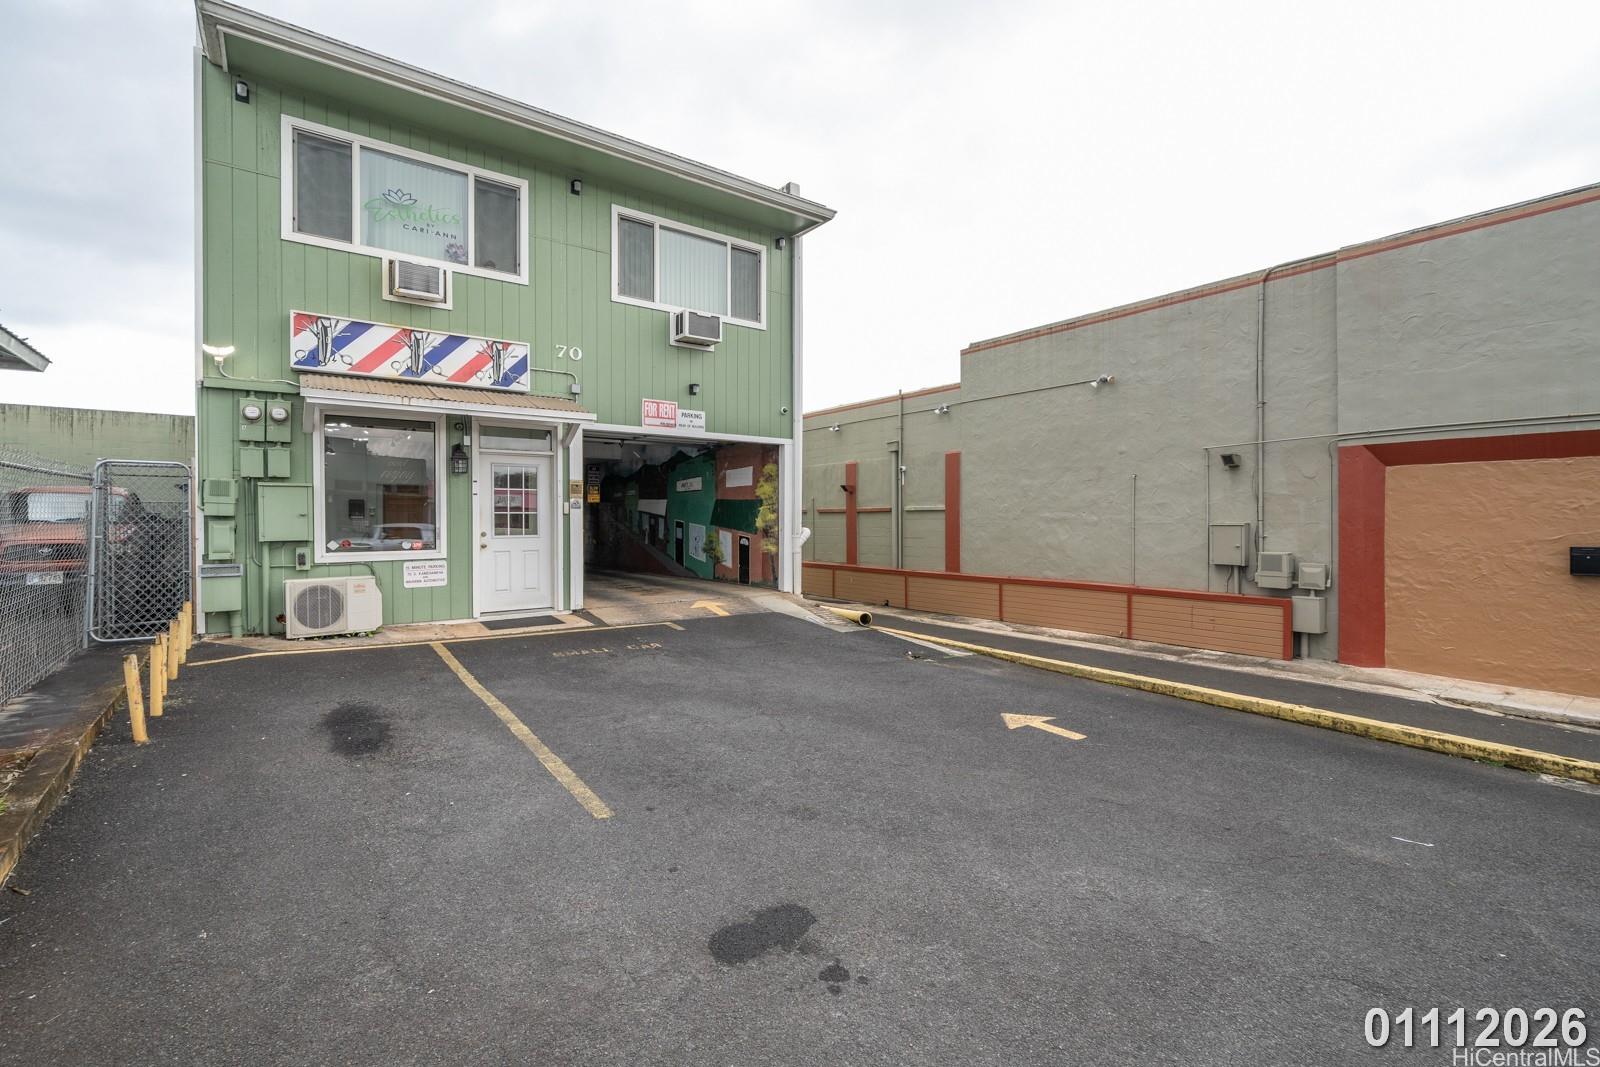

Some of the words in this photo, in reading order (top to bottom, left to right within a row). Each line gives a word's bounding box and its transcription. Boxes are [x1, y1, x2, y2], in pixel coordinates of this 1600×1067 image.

[555, 344, 582, 361] 70
[644, 402, 658, 417] FOR
[659, 404, 676, 419] RENT
[681, 412, 702, 420] PARKING
